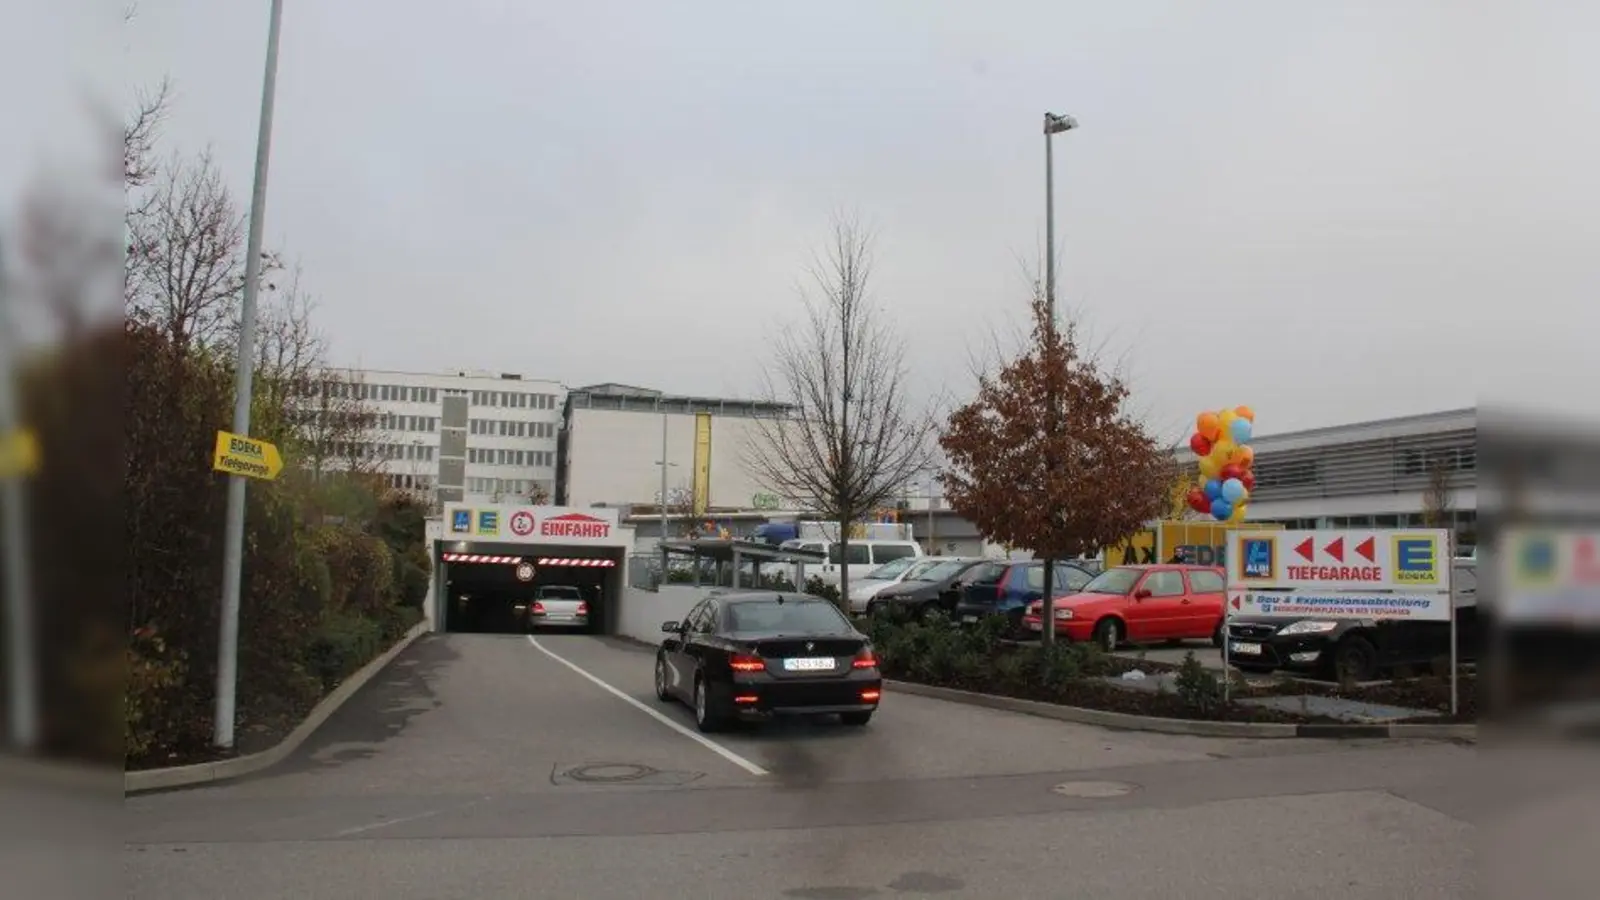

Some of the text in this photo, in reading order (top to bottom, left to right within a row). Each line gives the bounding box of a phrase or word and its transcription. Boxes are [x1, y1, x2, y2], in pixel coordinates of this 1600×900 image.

[541, 523, 611, 538] EINFAHRT
[1246, 564, 1269, 573] ALDI
[1287, 566, 1383, 581] TIEFGARAGE
[1398, 572, 1434, 580] EDEKA
